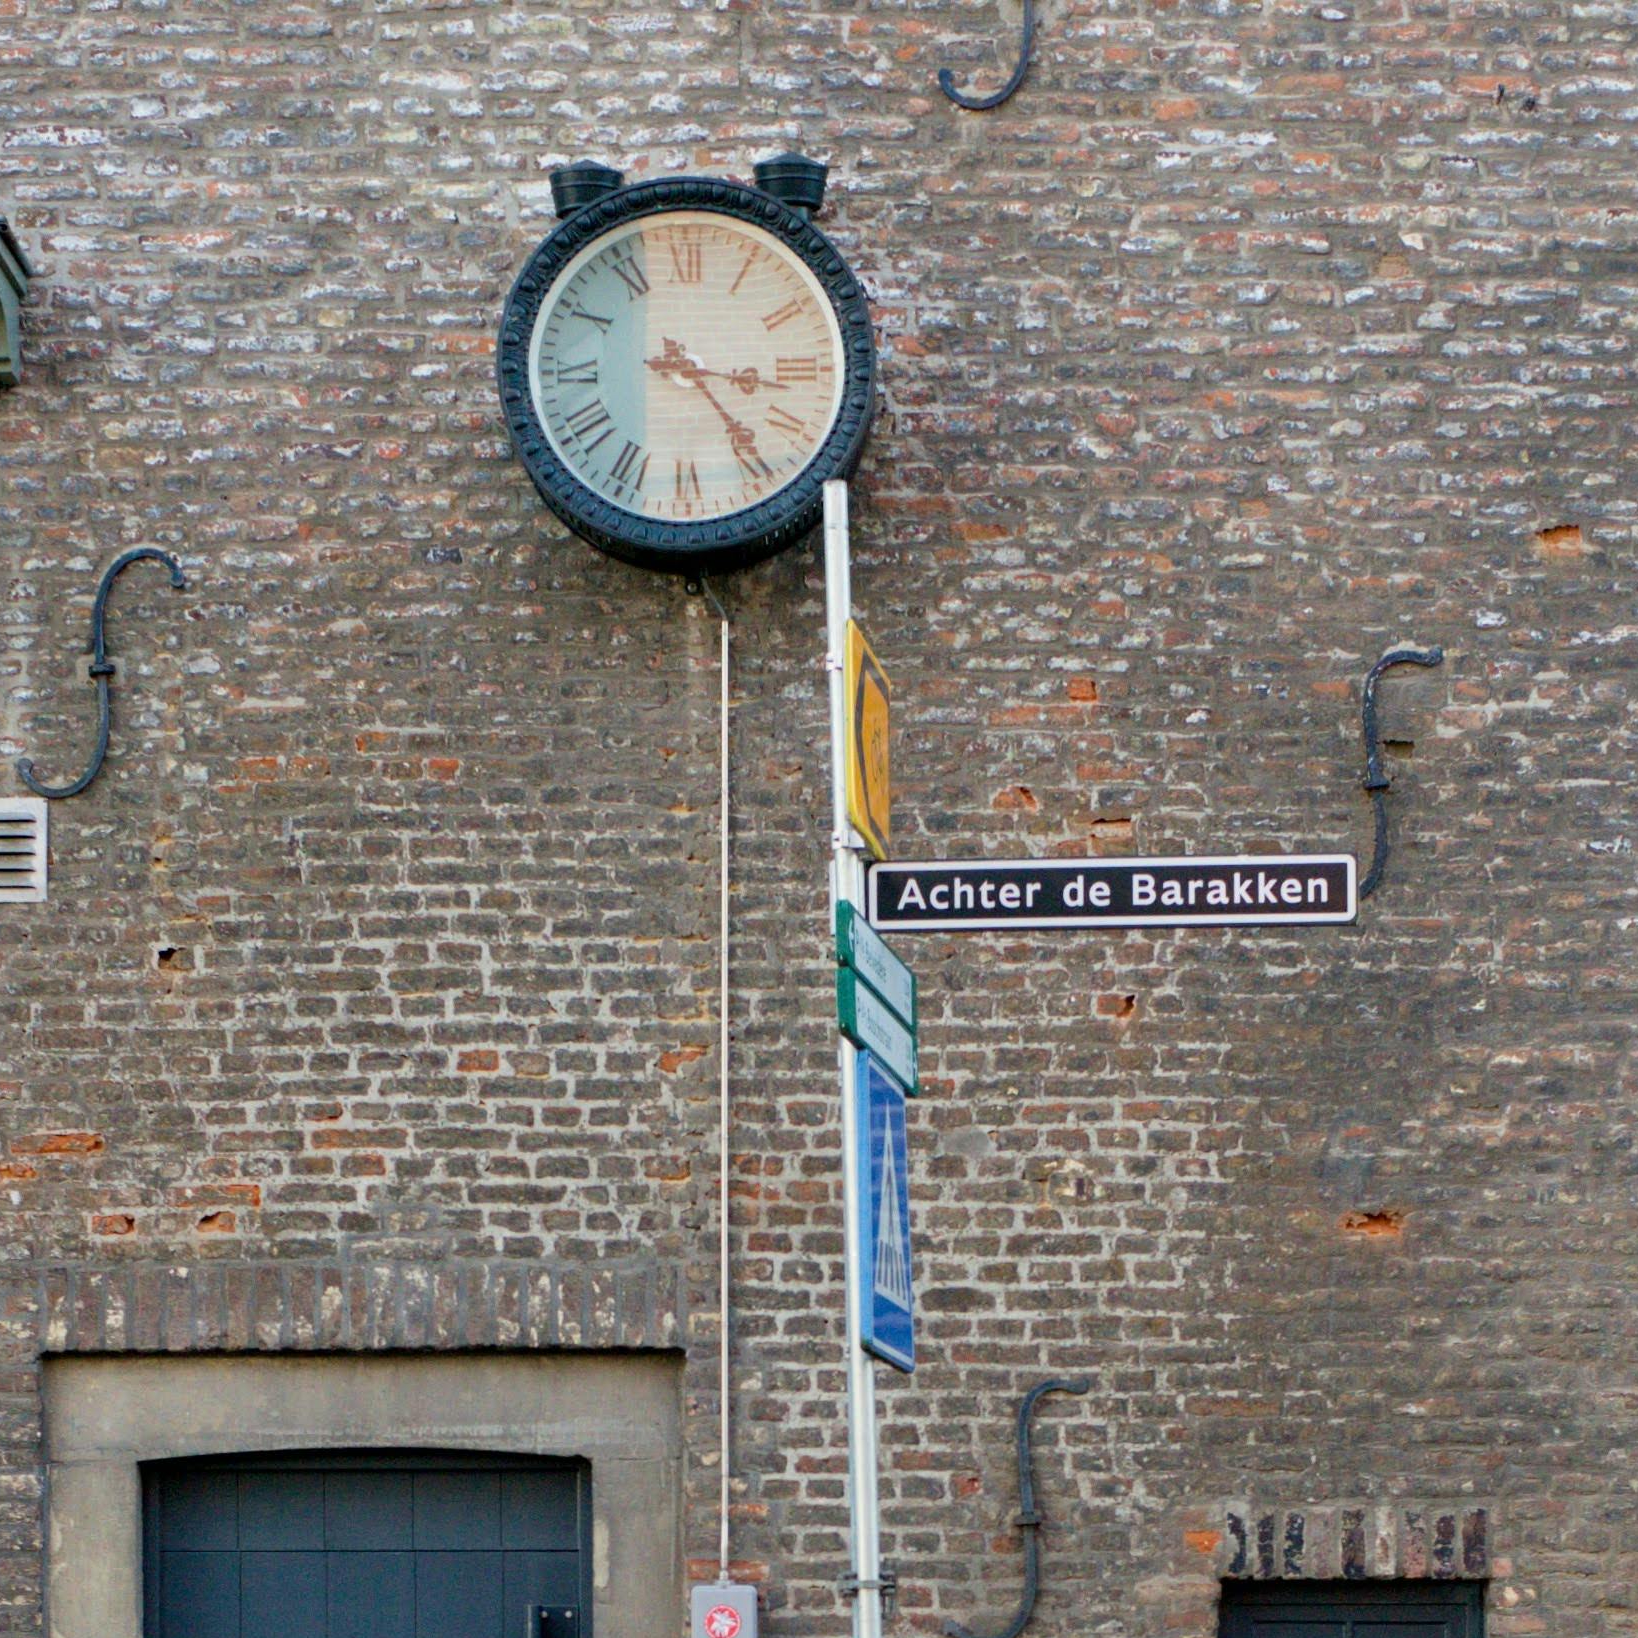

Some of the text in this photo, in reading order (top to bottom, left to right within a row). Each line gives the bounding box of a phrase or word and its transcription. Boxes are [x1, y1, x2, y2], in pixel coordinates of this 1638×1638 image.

[667, 242, 702, 284] XII
[775, 357, 818, 383] III
[897, 871, 1330, 912] Achter de Barakken
